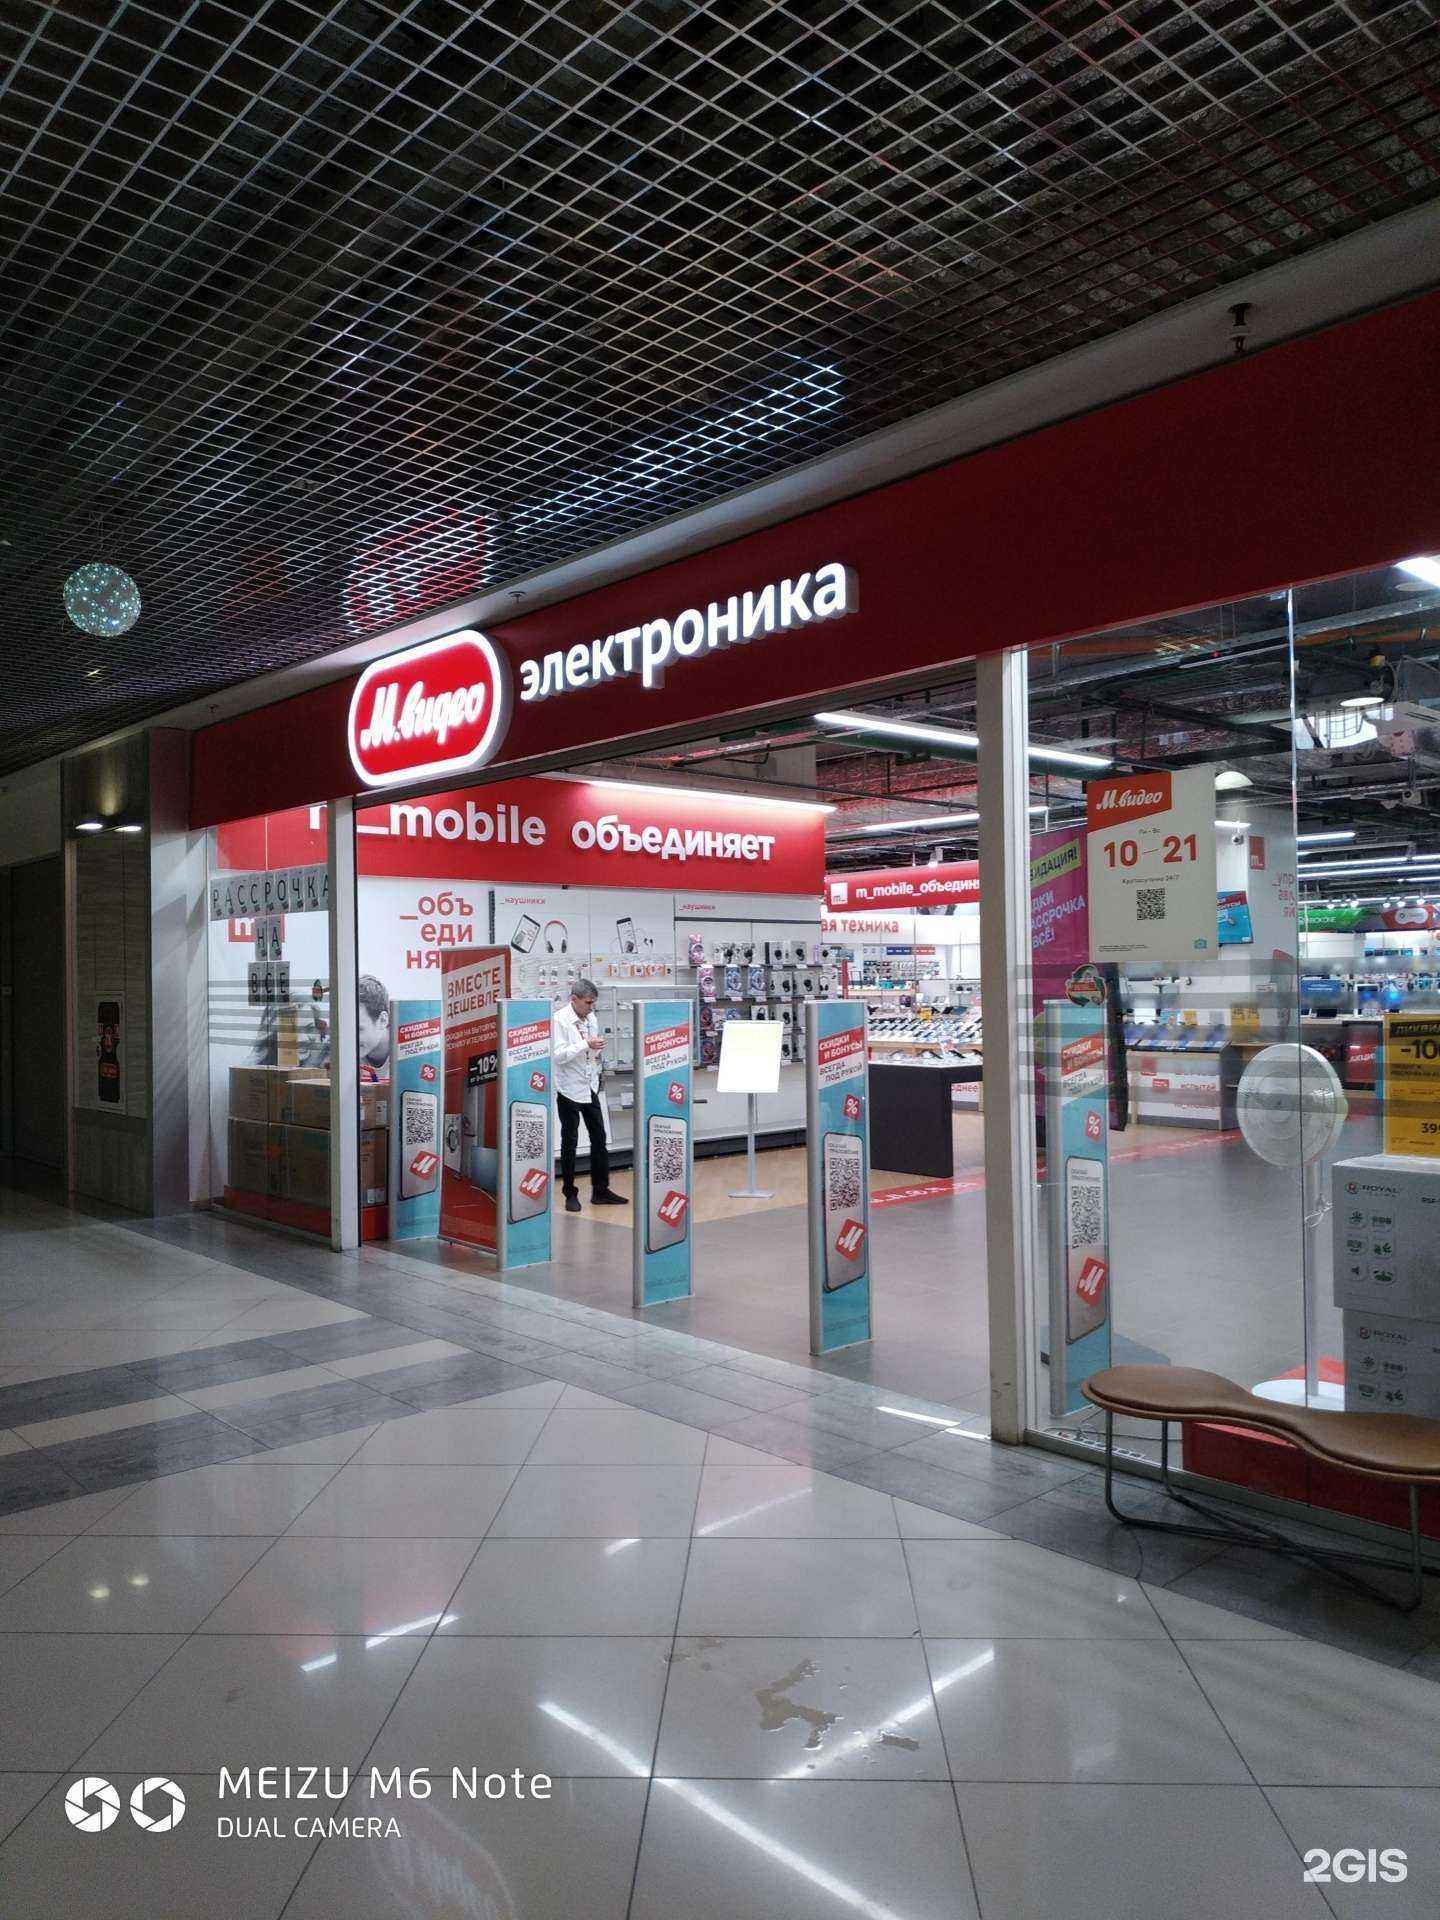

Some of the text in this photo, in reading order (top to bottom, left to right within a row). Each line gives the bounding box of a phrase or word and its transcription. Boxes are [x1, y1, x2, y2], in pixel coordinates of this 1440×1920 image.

[360, 562, 847, 750] М.видео электроника
[1096, 789, 1163, 810] М.видео
[572, 815, 776, 861] объединяет
[1104, 840, 1138, 867] 10
[1163, 834, 1197, 863] 21
[400, 891, 474, 920] _объ
[257, 926, 281, 948] НА
[421, 923, 473, 946] еди
[842, 918, 899, 934] техника
[252, 972, 286, 994] ВСЕ
[447, 966, 501, 999] ВМЕСТЕ
[447, 989, 500, 1019] ДЕШЕВЛЕ
[820, 1034, 850, 1050] СКИДКИ
[831, 1040, 863, 1058] БОНУСЫ
[1401, 1039, 1440, 1060] -10
[819, 1061, 846, 1076] ВСЕГДА
[1421, 1122, 1440, 1135] 39
[1361, 1184, 1400, 1194] ROYAL
